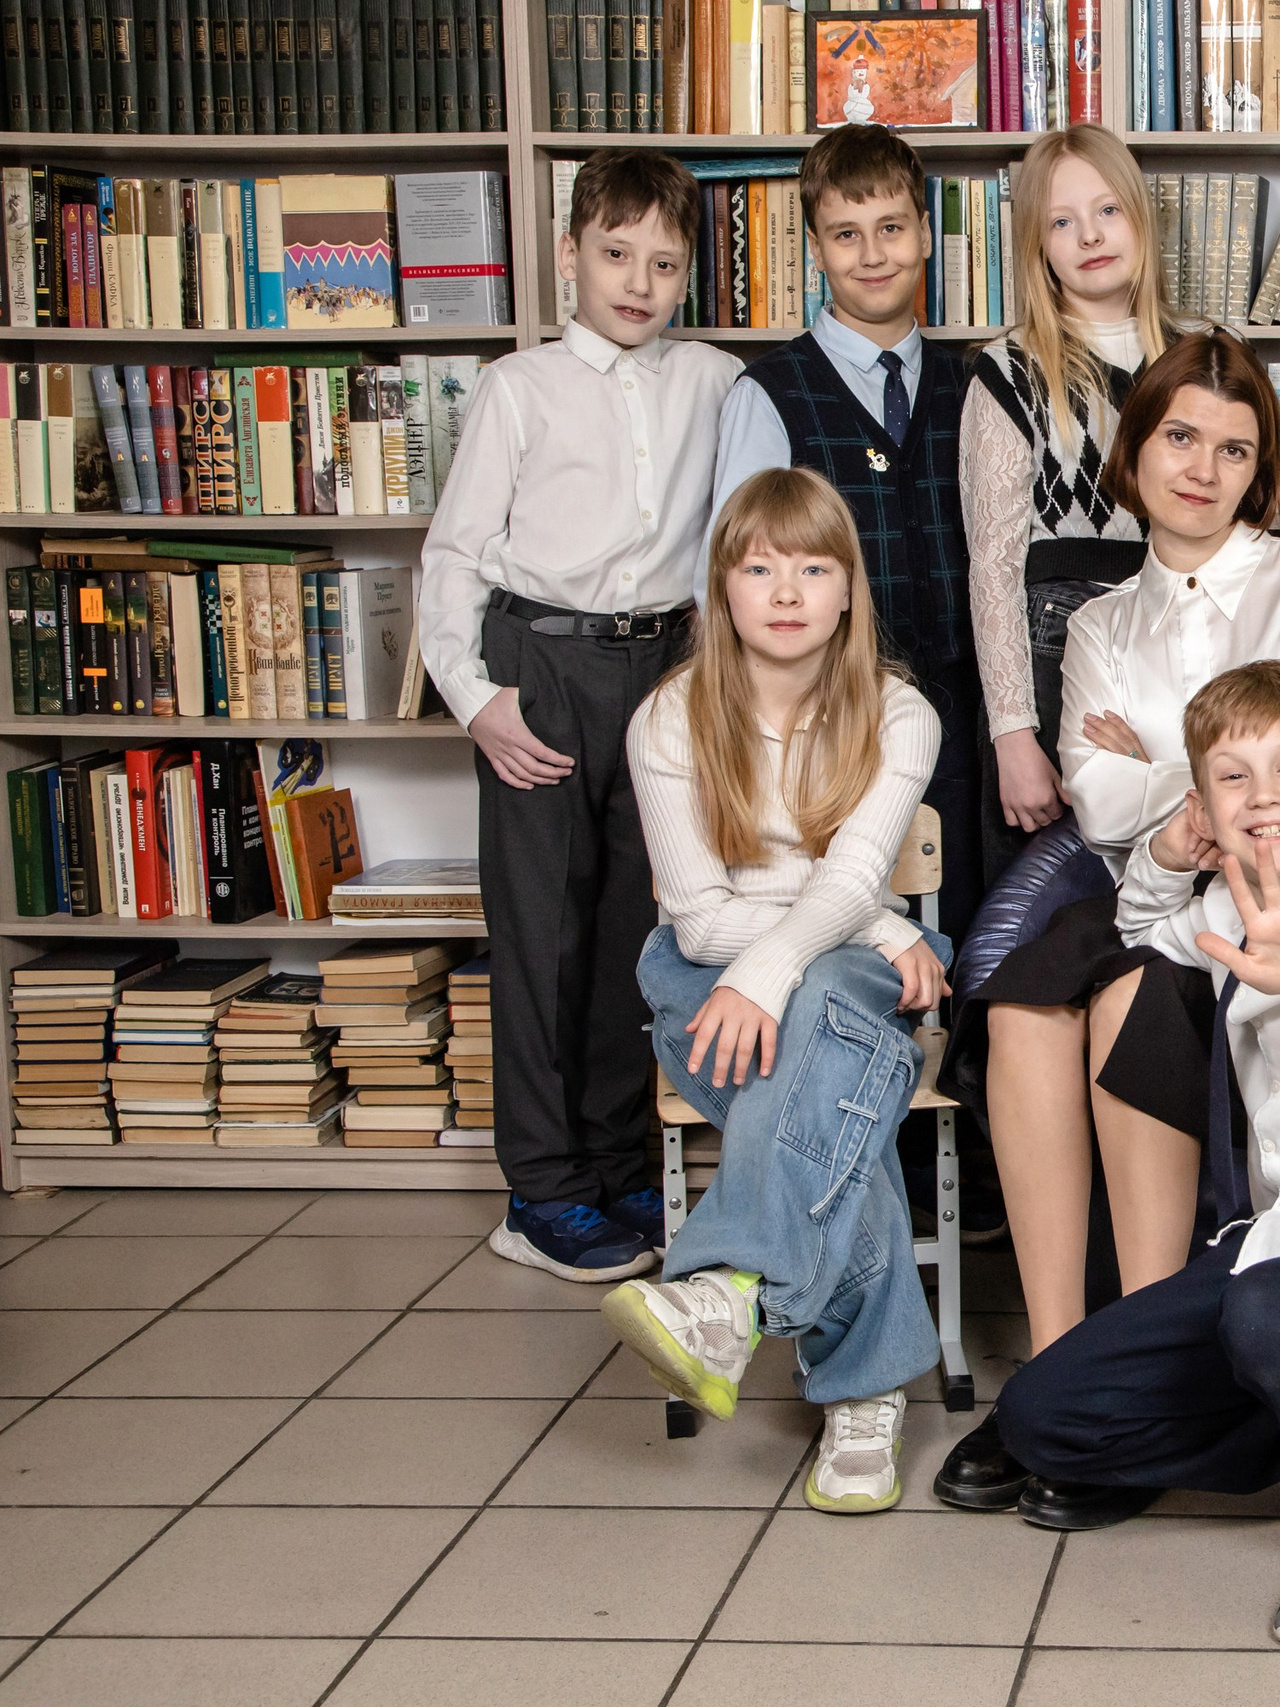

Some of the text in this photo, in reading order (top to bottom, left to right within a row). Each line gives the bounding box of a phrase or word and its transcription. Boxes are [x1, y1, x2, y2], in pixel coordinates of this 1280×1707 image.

[1156, 40, 1166, 106] ДЮМА ЖОЗЕФ
[1184, 41, 1193, 107] ДЮМА ЖОЗЕФ
[244, 189, 254, 249] ВОДОЛЕЧЕНИЕ
[786, 192, 796, 267] Купер Пионеры
[87, 232, 96, 284] ГЛАДИАТОР
[562, 282, 570, 302] МИГЕЛЬ
[193, 400, 214, 508] ПИРС
[210, 400, 236, 508] ПИРС
[242, 398, 255, 485] Елизавета Английская
[318, 434, 326, 449] Джон
[335, 376, 350, 488] ПОЛОСАТЫЙ ЭРГЕНИ
[384, 434, 410, 496] КРАУЛИ
[226, 626, 245, 702] Непогребенный
[308, 657, 320, 690] ПРУСТ
[329, 654, 342, 690] ПРУСТ
[210, 762, 220, 789] Д.Хан
[112, 783, 130, 904] Ваши домашние четвероногие друзья
[136, 800, 146, 852] МЕНЕДЖМЕНТ
[212, 817, 220, 856] контроль
[218, 808, 228, 868] Планирование
[342, 897, 404, 908] ГРАМОТА
